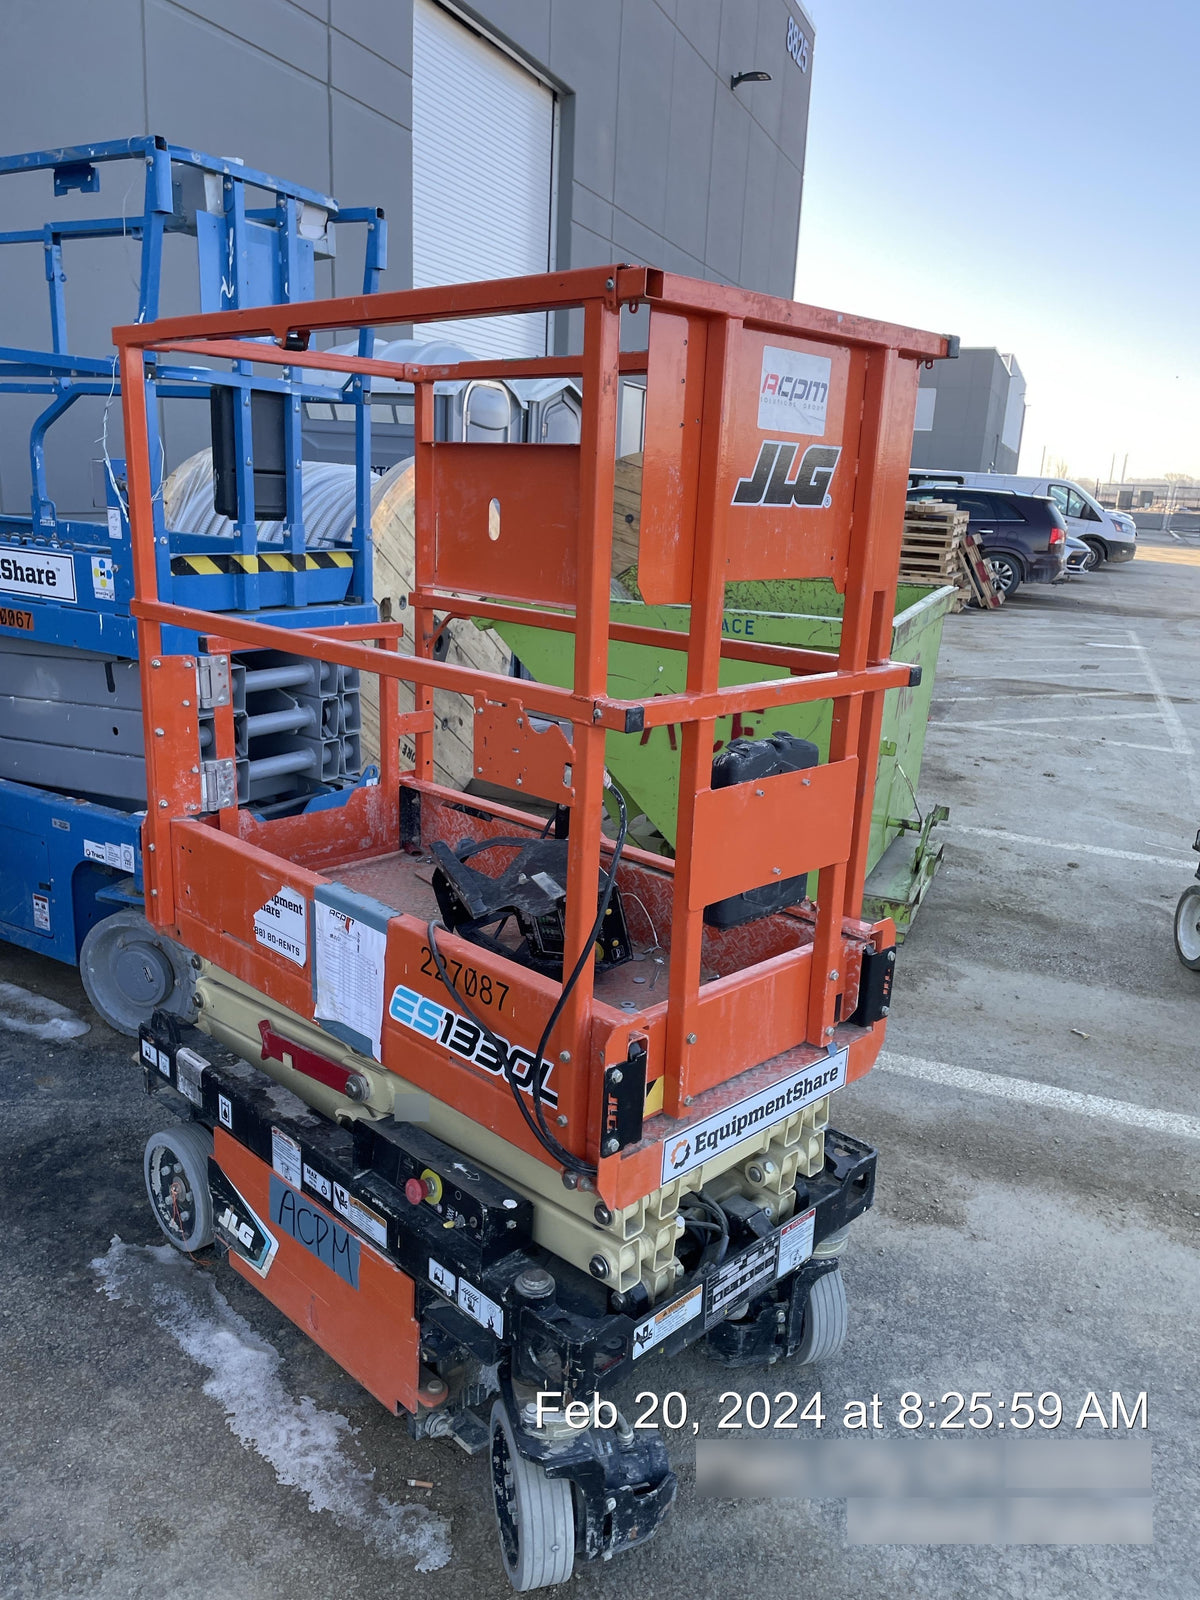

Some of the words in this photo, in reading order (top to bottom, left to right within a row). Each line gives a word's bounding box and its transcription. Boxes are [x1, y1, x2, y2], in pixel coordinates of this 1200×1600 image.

[786, 16, 808, 73] 8825
[730, 439, 843, 508] JLG
[0, 558, 57, 587] Share
[420, 946, 510, 1011] 227087
[389, 985, 558, 1109] ES1330L
[607, 1091, 619, 1131] JLG
[693, 1066, 840, 1155] EquipmentShare
[217, 1206, 256, 1249] JLG
[278, 1190, 354, 1285] ACPM
